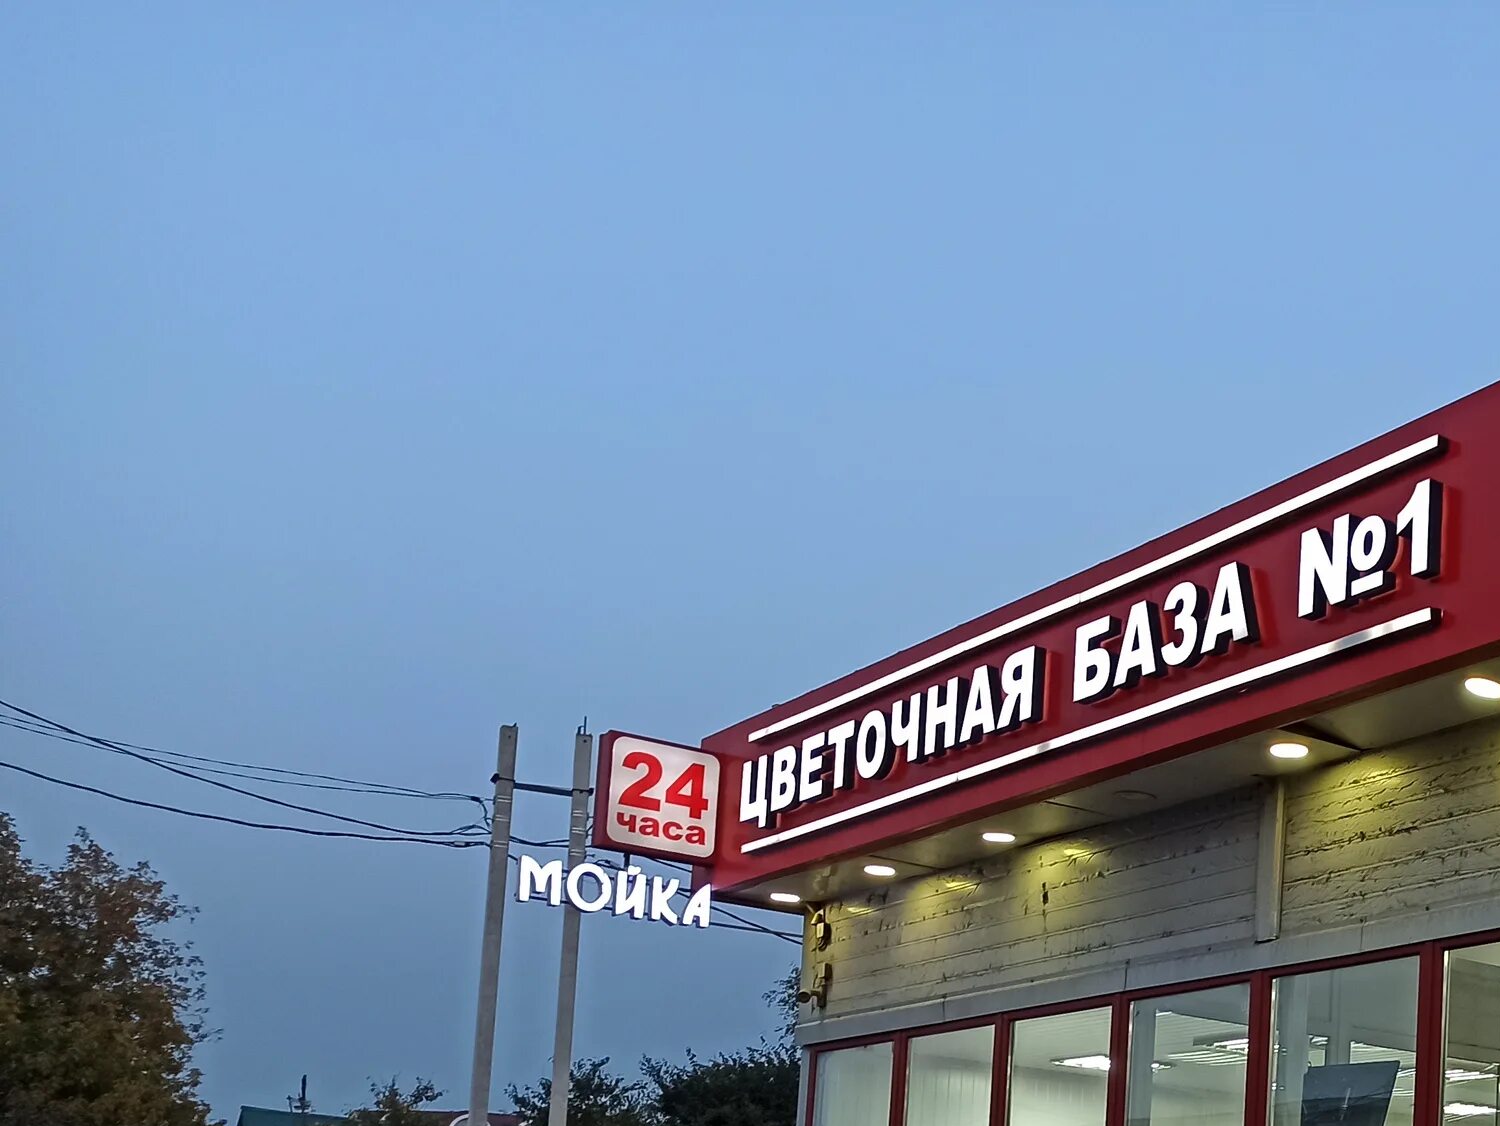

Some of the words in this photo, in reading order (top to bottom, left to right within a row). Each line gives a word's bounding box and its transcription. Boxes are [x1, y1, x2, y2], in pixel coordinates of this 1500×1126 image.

[739, 646, 1040, 828] ЦВЕТОЧНАЯ
[1073, 561, 1251, 702] БАЗА
[1298, 479, 1438, 617] №1
[618, 751, 709, 820] 24
[616, 811, 707, 847] часа
[519, 854, 712, 928] МОЙКА
